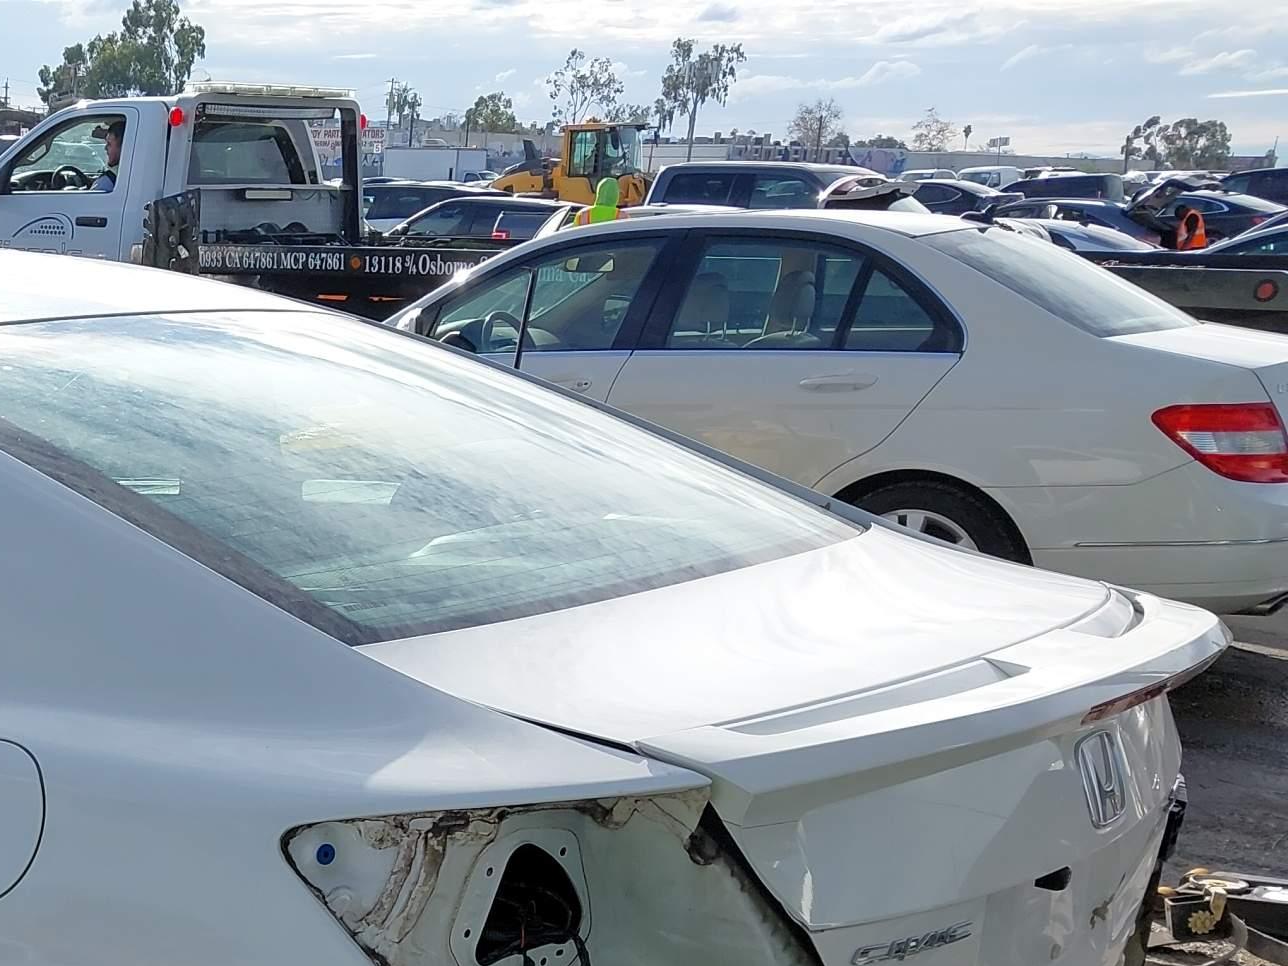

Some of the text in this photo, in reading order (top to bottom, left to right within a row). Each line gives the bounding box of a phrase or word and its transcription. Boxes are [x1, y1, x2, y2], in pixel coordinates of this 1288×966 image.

[375, 144, 381, 153] 5
[226, 253, 240, 268] CA
[243, 252, 277, 269] 647861
[280, 253, 305, 270] MCP
[308, 252, 345, 271] 647861
[365, 256, 402, 274] 13118
[850, 919, 974, 966] CIVIC
